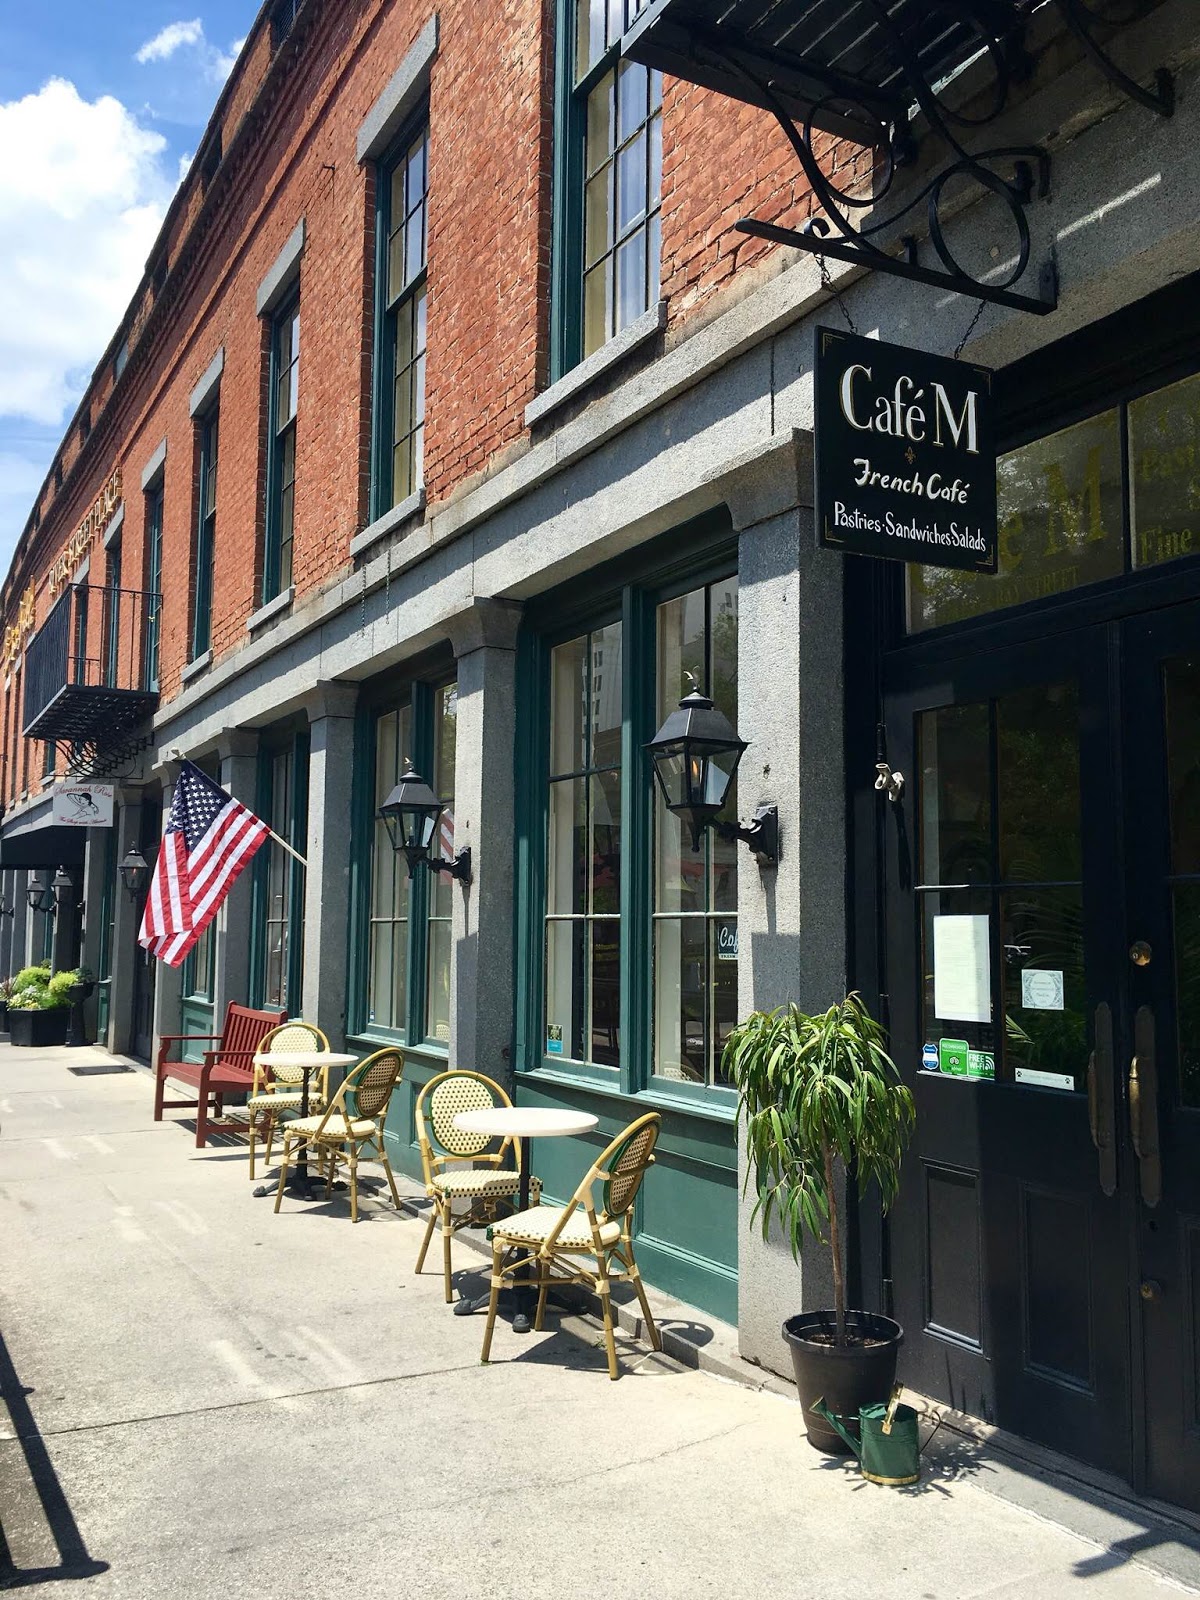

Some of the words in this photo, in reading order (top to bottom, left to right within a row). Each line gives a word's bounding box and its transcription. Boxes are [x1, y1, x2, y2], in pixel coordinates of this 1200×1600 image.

[840, 364, 926, 441] Café
[930, 382, 980, 454] M
[853, 458, 924, 496] French
[926, 473, 970, 504] Café
[834, 501, 881, 531] Pastries
[885, 511, 951, 546] Sandwiches
[951, 522, 987, 552] Salads
[1140, 525, 1193, 566] Fine
[54, 784, 91, 797] Savannah
[969, 1053, 984, 1063] FREE
